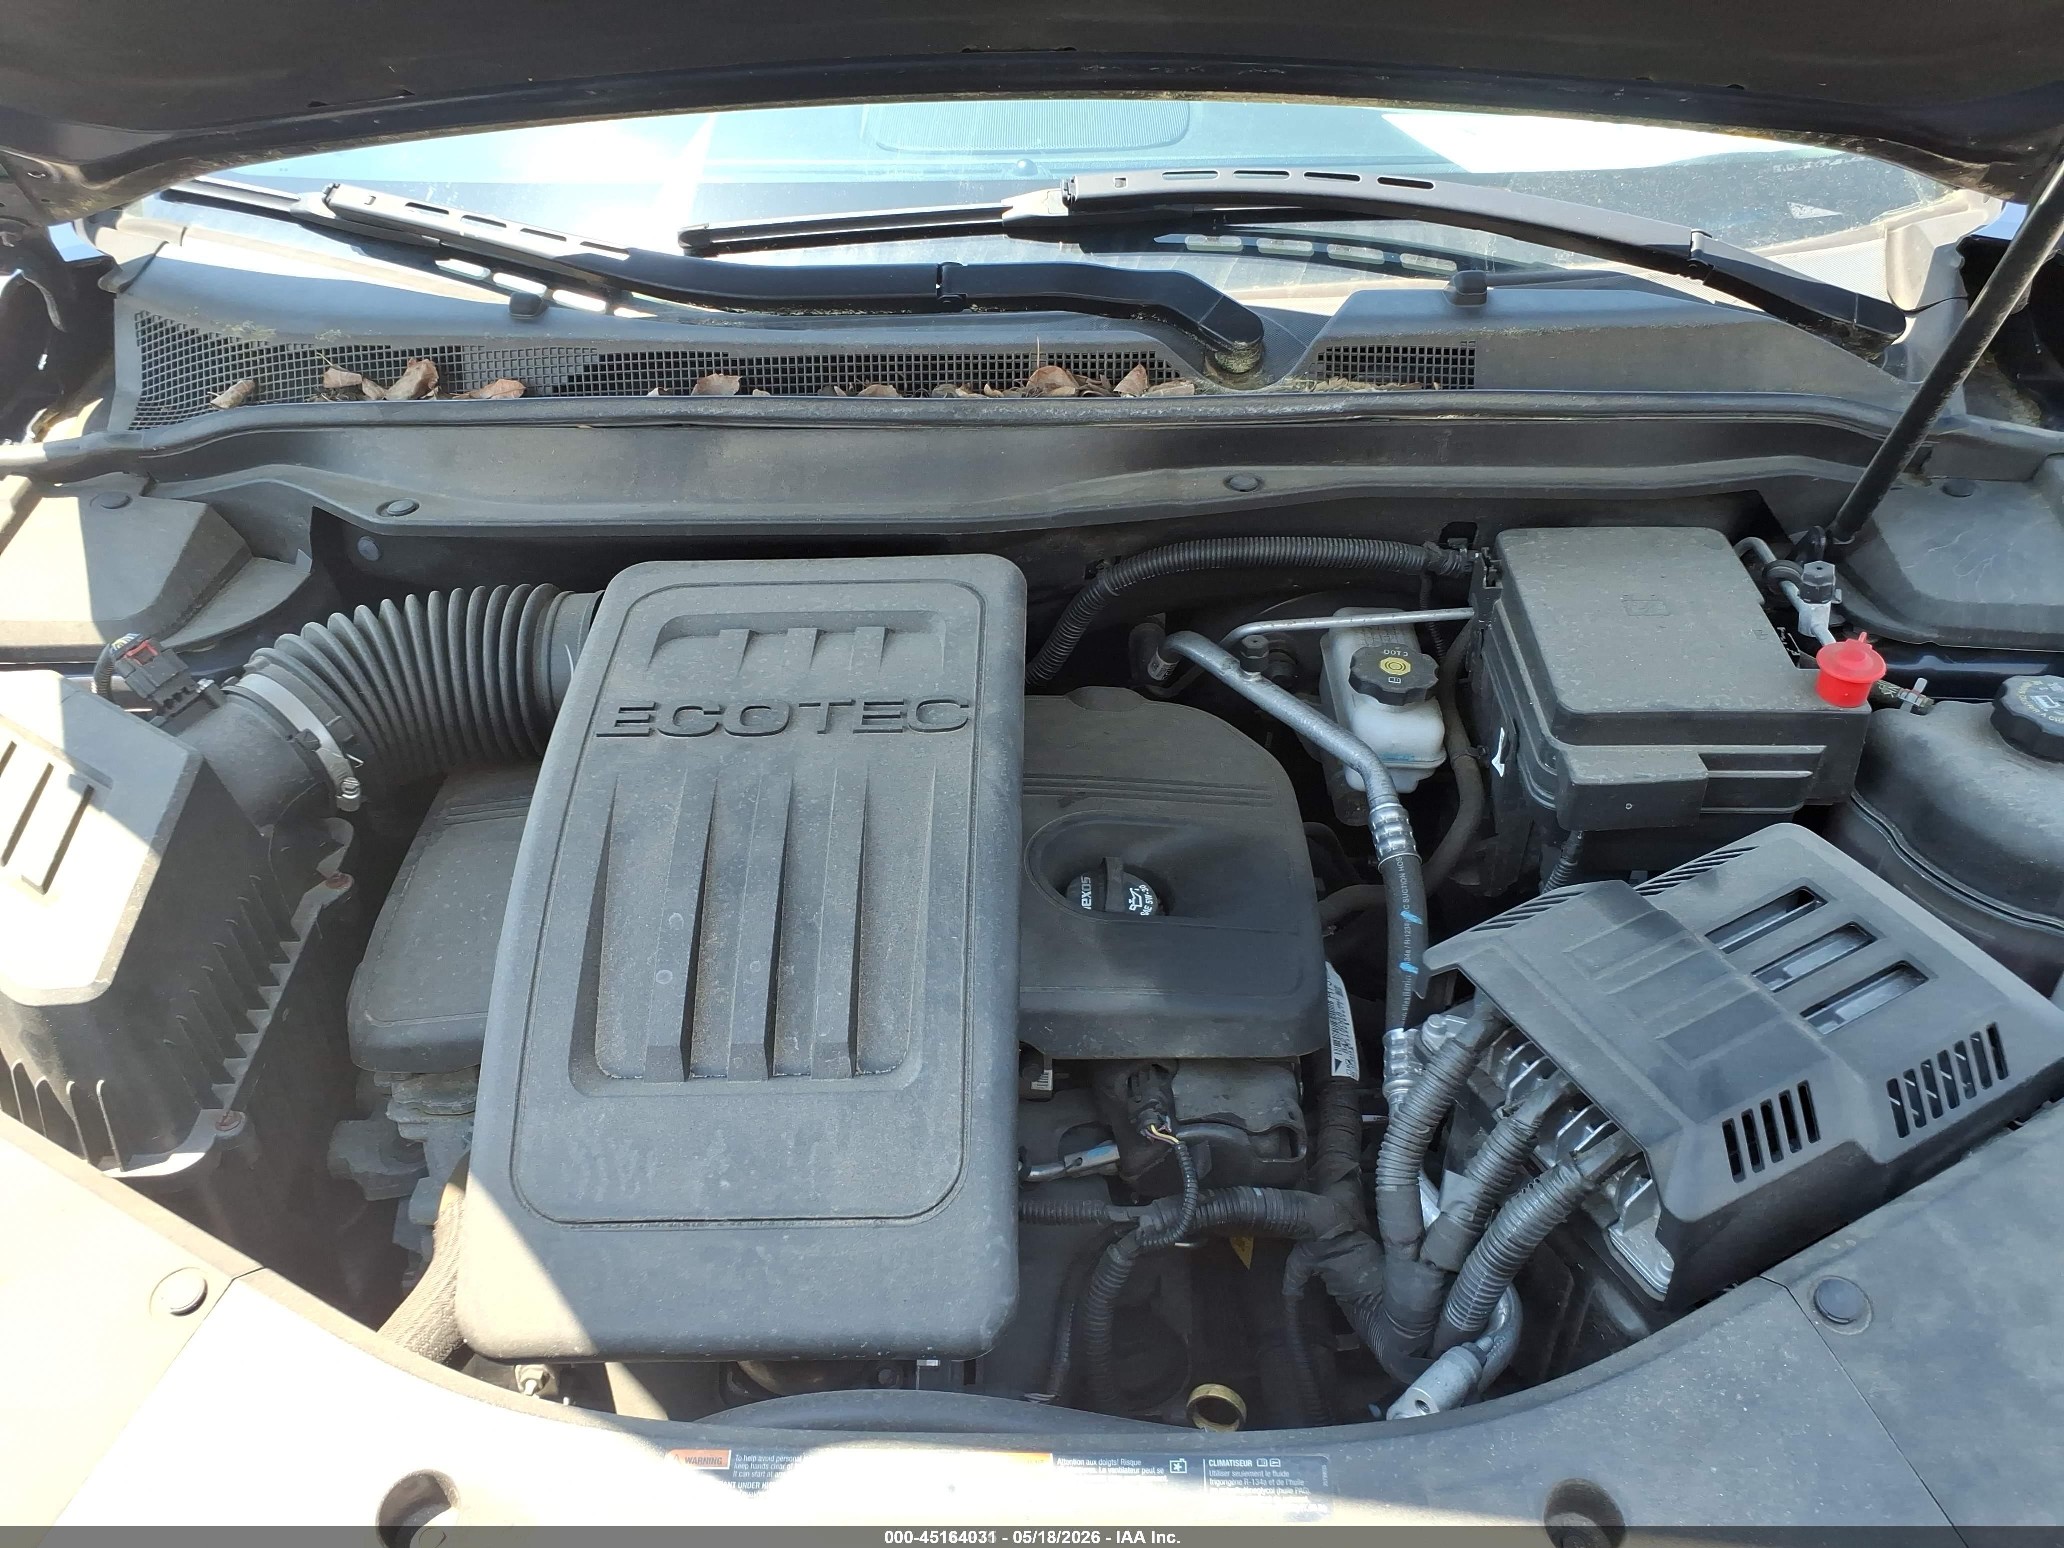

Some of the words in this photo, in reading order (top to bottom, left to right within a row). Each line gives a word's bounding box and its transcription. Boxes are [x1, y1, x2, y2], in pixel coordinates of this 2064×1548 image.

[595, 697, 971, 738] ECOTEC
[1395, 855, 1405, 872] HOS
[1400, 872, 1410, 903] SUCTION
[1139, 884, 1154, 905] 5W-30
[1140, 905, 1153, 916] SAE
[684, 1456, 723, 1465] WARNING
[735, 1454, 743, 1462] To
[743, 1454, 757, 1463] help
[758, 1454, 775, 1462] avoid
[1056, 1458, 1085, 1467] Attention
[1098, 1458, 1119, 1467] doigts!
[1120, 1458, 1141, 1467] Risque
[1208, 1459, 1253, 1467] CLIMATISEUR
[750, 1462, 769, 1470] hands
[770, 1462, 785, 1470] clear
[751, 1470, 766, 1478] start
[1141, 1467, 1155, 1475] peut
[1272, 1470, 1290, 1478] fluide
[737, 1481, 760, 1489] UNDER
[1243, 1478, 1267, 1486] R-134a
[1276, 1478, 1285, 1486] de
